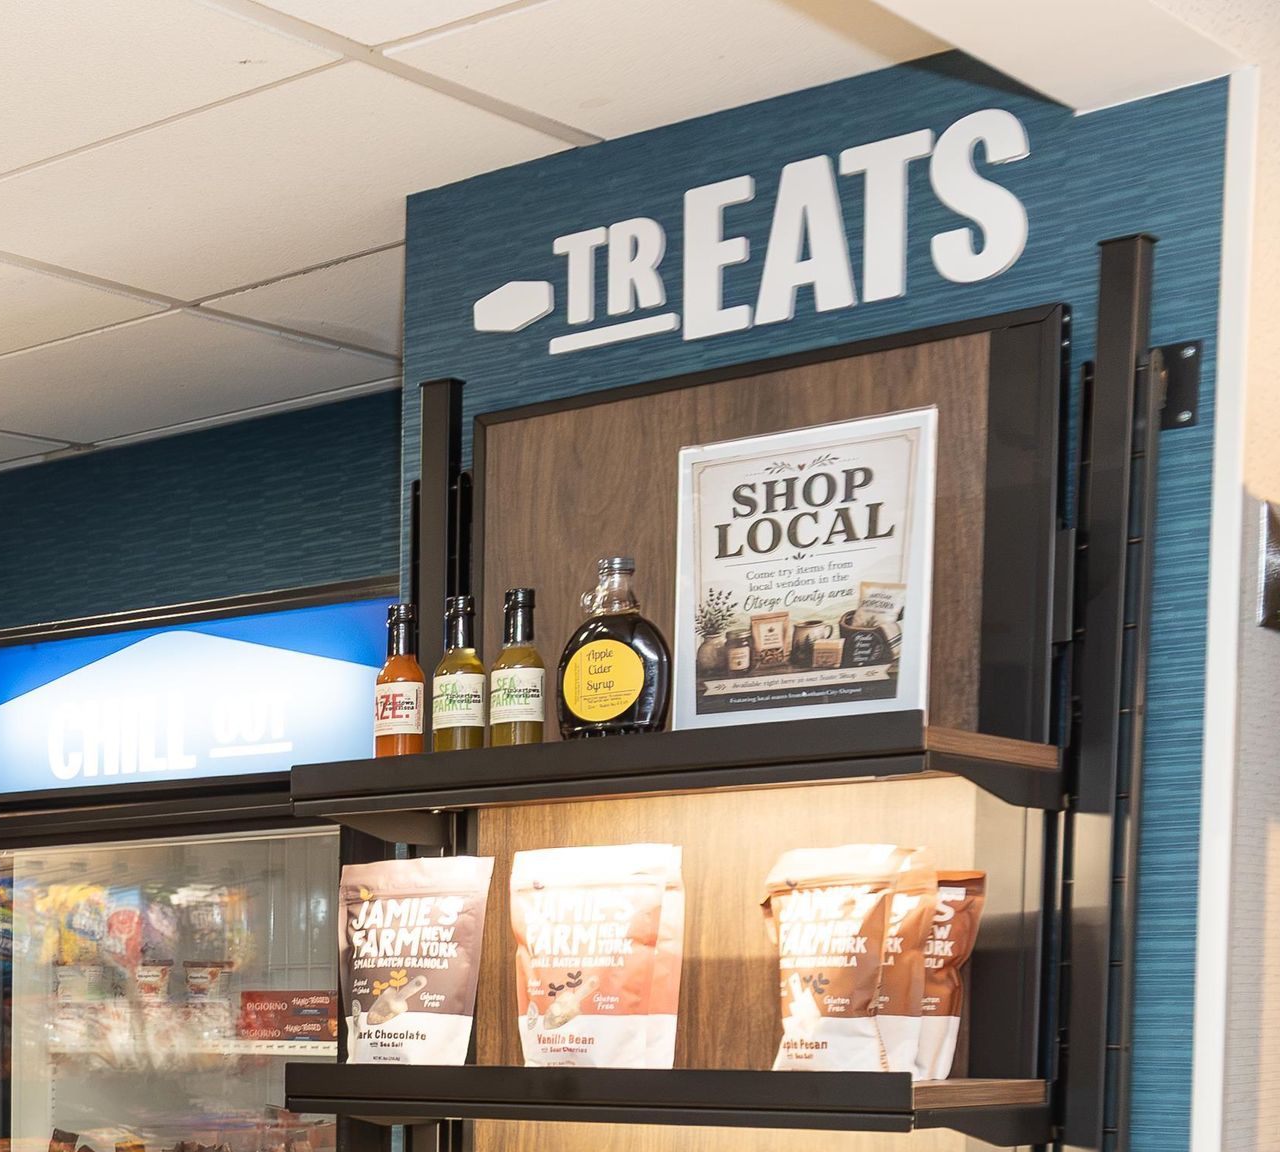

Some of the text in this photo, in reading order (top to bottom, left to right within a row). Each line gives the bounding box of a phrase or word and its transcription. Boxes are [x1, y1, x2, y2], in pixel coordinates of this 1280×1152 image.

[550, 108, 1031, 347] TREATS
[731, 466, 874, 520] SHOP
[714, 502, 896, 559] LOCAL
[746, 561, 854, 581] Come try items from
[749, 573, 850, 592] local vendors in the
[784, 589, 825, 607] County
[828, 587, 854, 598] area
[585, 648, 614, 662] Apple
[588, 664, 612, 675] Cider
[586, 679, 614, 692] Syrup
[352, 895, 465, 930] JAMIE'S
[352, 926, 455, 959] FARM NEW
[421, 941, 459, 958] YORK
[353, 957, 449, 970] SMALL BATCH GRANOLA
[419, 991, 446, 1001] Gluten
[593, 993, 620, 1002] Gluten
[823, 996, 850, 1005] Gluten
[423, 1000, 441, 1008] Free
[597, 1002, 615, 1010] Free
[374, 1029, 427, 1041] Chocolate
[537, 1034, 595, 1045] Vanilla Bean
[799, 1039, 828, 1050] Pecan
